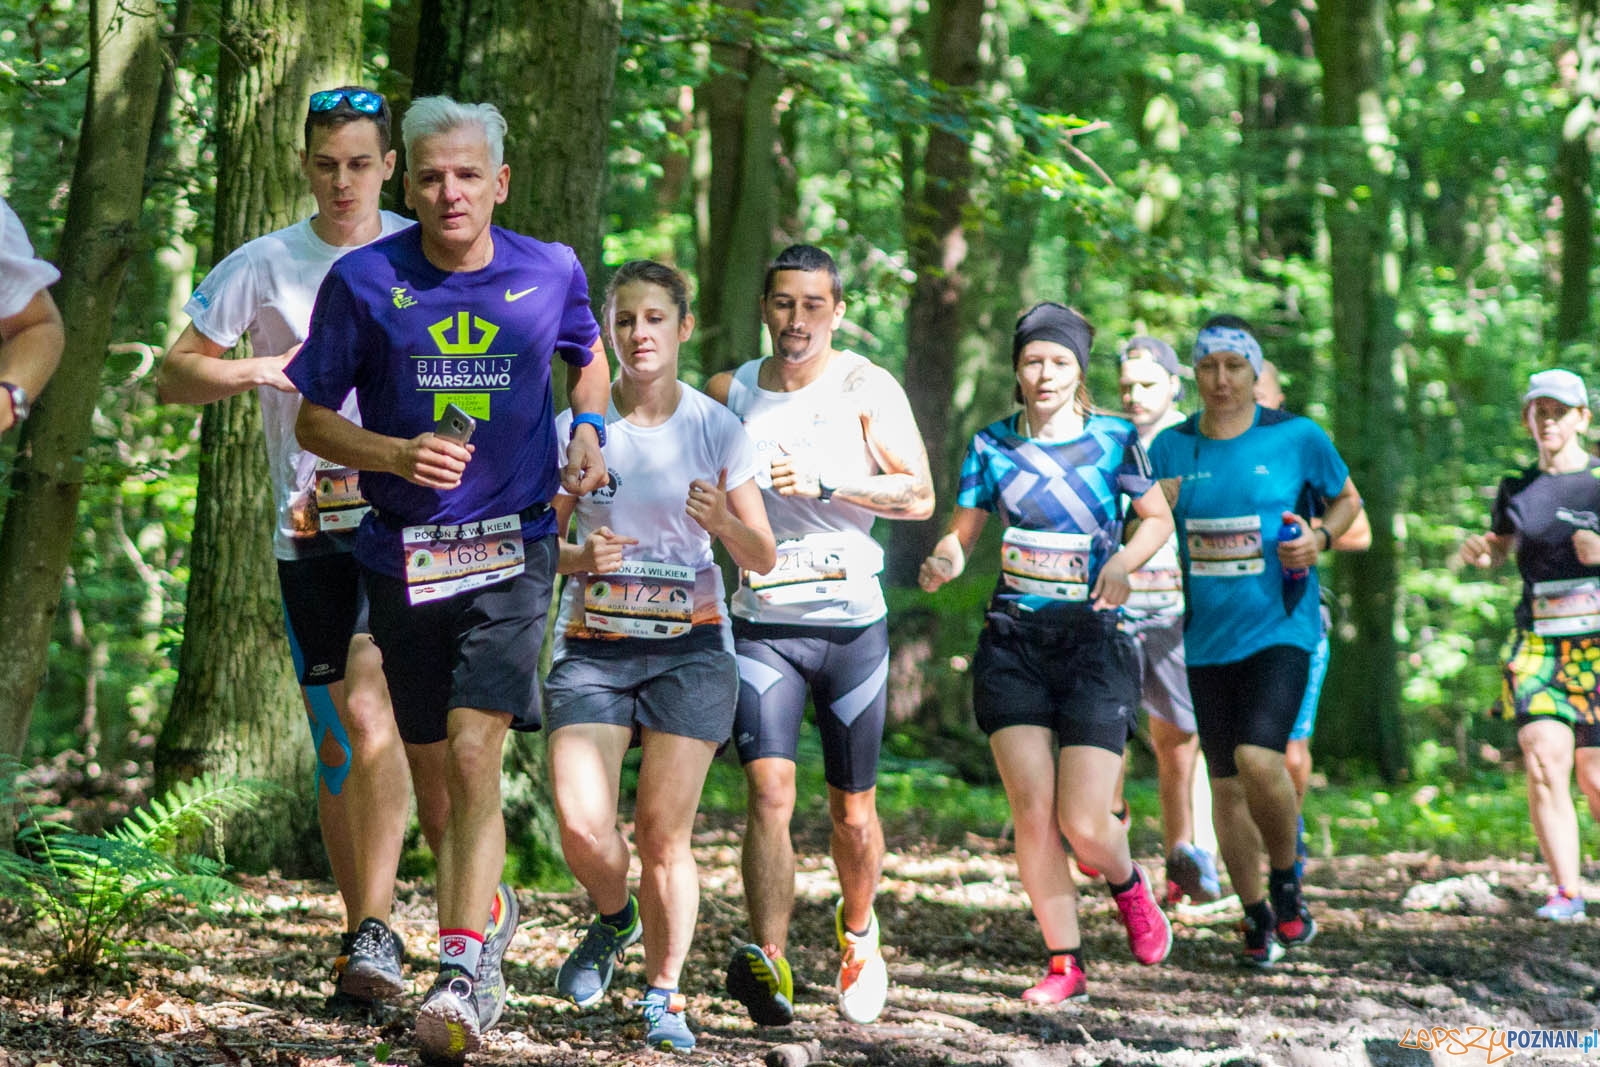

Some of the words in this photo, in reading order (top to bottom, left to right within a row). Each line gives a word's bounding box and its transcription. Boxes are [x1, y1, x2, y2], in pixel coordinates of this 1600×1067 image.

[417, 359, 512, 374] BIEGNIJ
[417, 373, 511, 387] WARSZAWO
[443, 542, 488, 567] 168
[1026, 550, 1064, 569] 427
[633, 567, 646, 575] ZA
[648, 567, 688, 579] WILKIEM
[622, 582, 662, 604] 172
